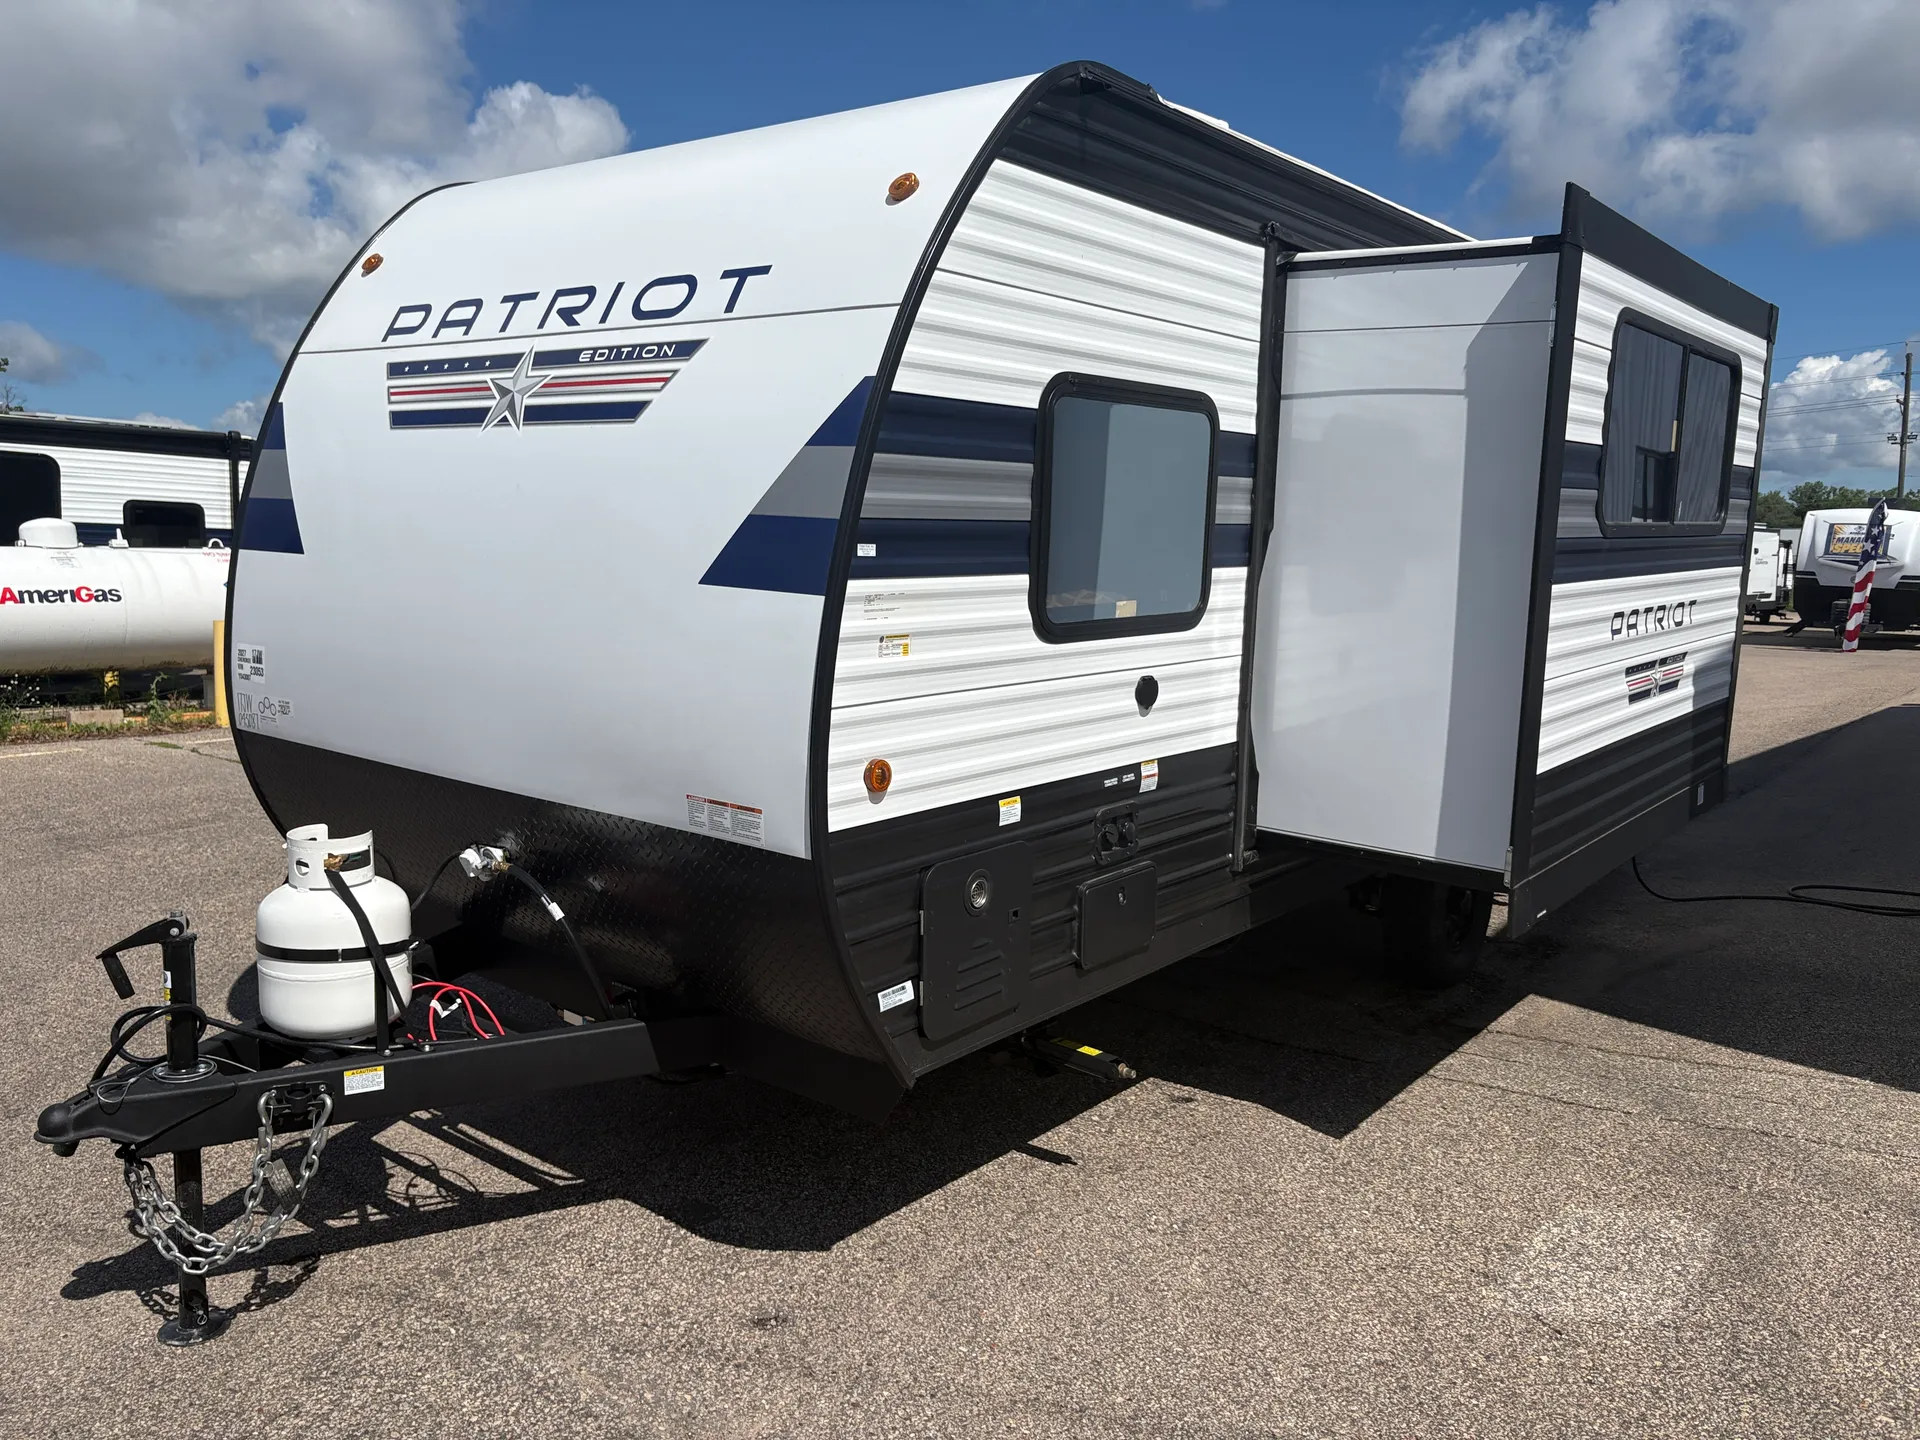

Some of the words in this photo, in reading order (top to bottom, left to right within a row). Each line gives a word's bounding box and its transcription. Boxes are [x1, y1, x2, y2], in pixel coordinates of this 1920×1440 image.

[381, 264, 773, 342] PATRIOT
[578, 344, 676, 362] EDITION
[0, 586, 123, 605] AmeriGas
[1610, 599, 1697, 641] PATRIOT
[249, 665, 265, 678] 23053
[355, 1067, 378, 1075] CAUTION
